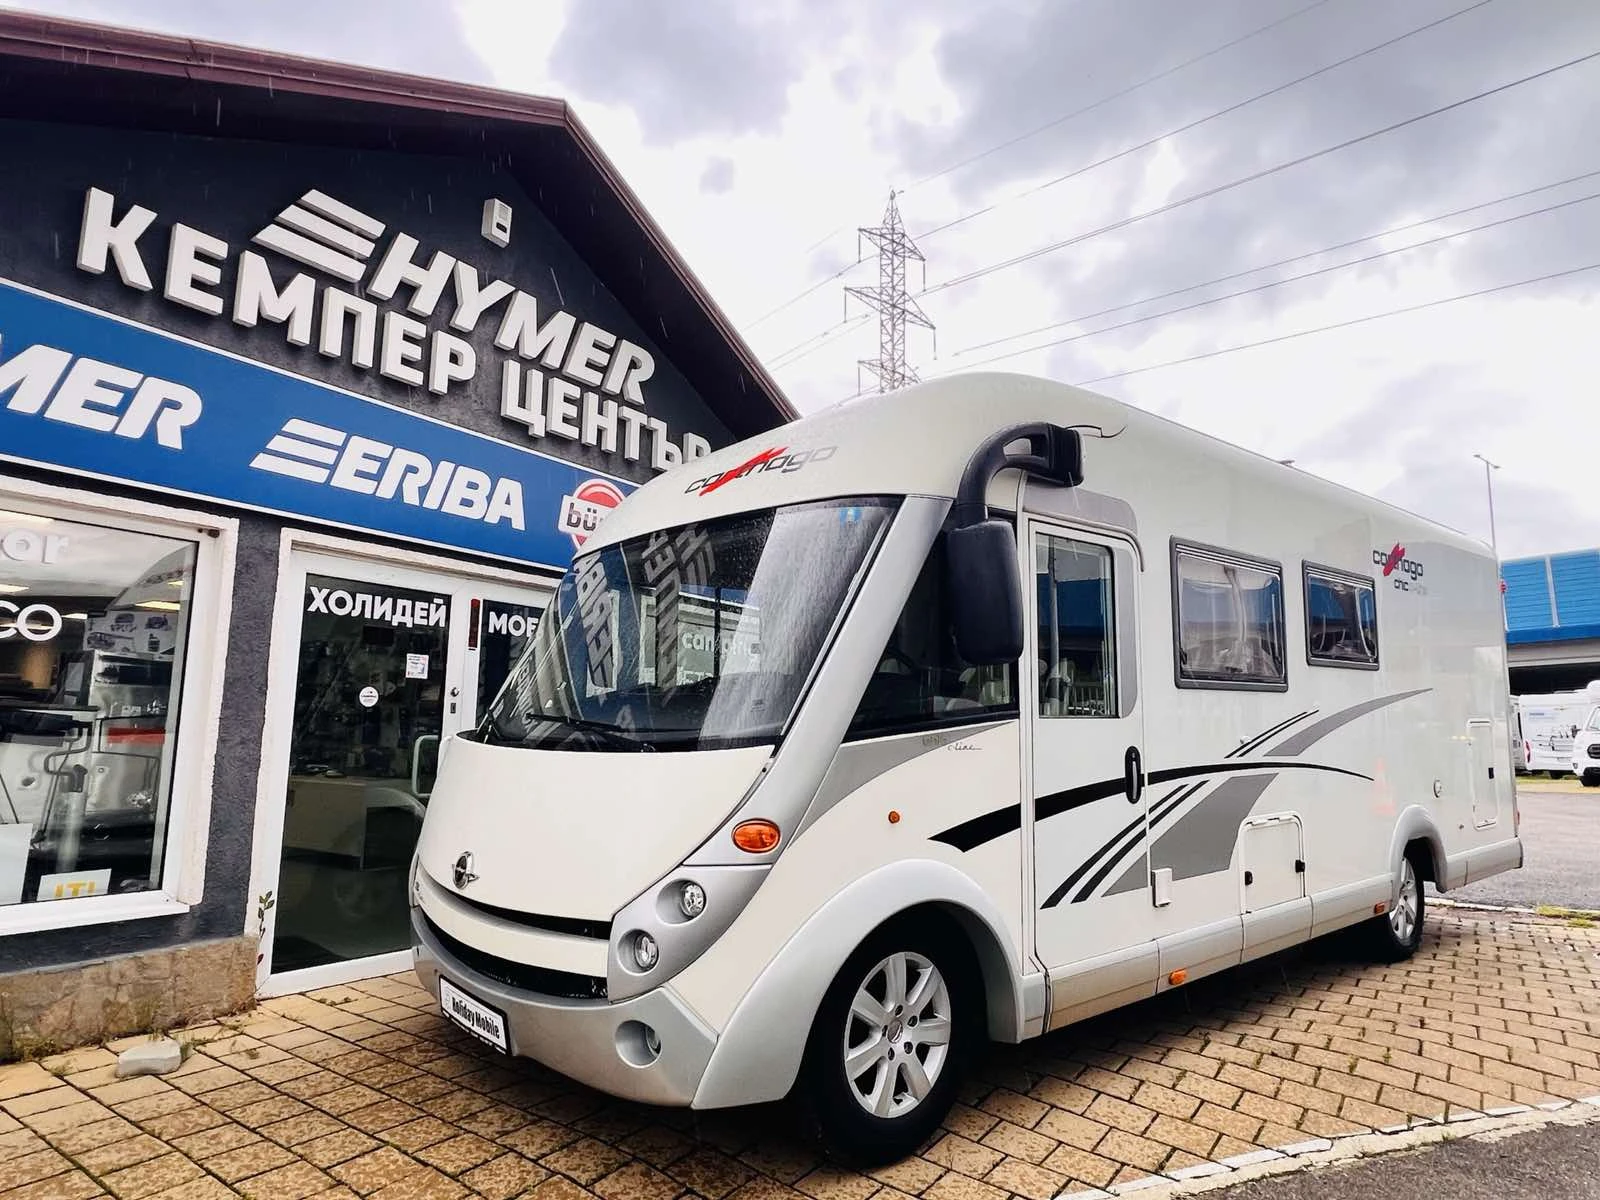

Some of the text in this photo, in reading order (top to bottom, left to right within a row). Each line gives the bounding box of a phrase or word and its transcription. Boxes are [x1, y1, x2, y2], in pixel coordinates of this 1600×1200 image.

[77, 187, 711, 472] КЕМПЕР ЦЕНТЪР
[366, 231, 655, 405] HYMER
[330, 435, 526, 531] ERIBA
[307, 586, 446, 629] ХОЛИДЕЙ
